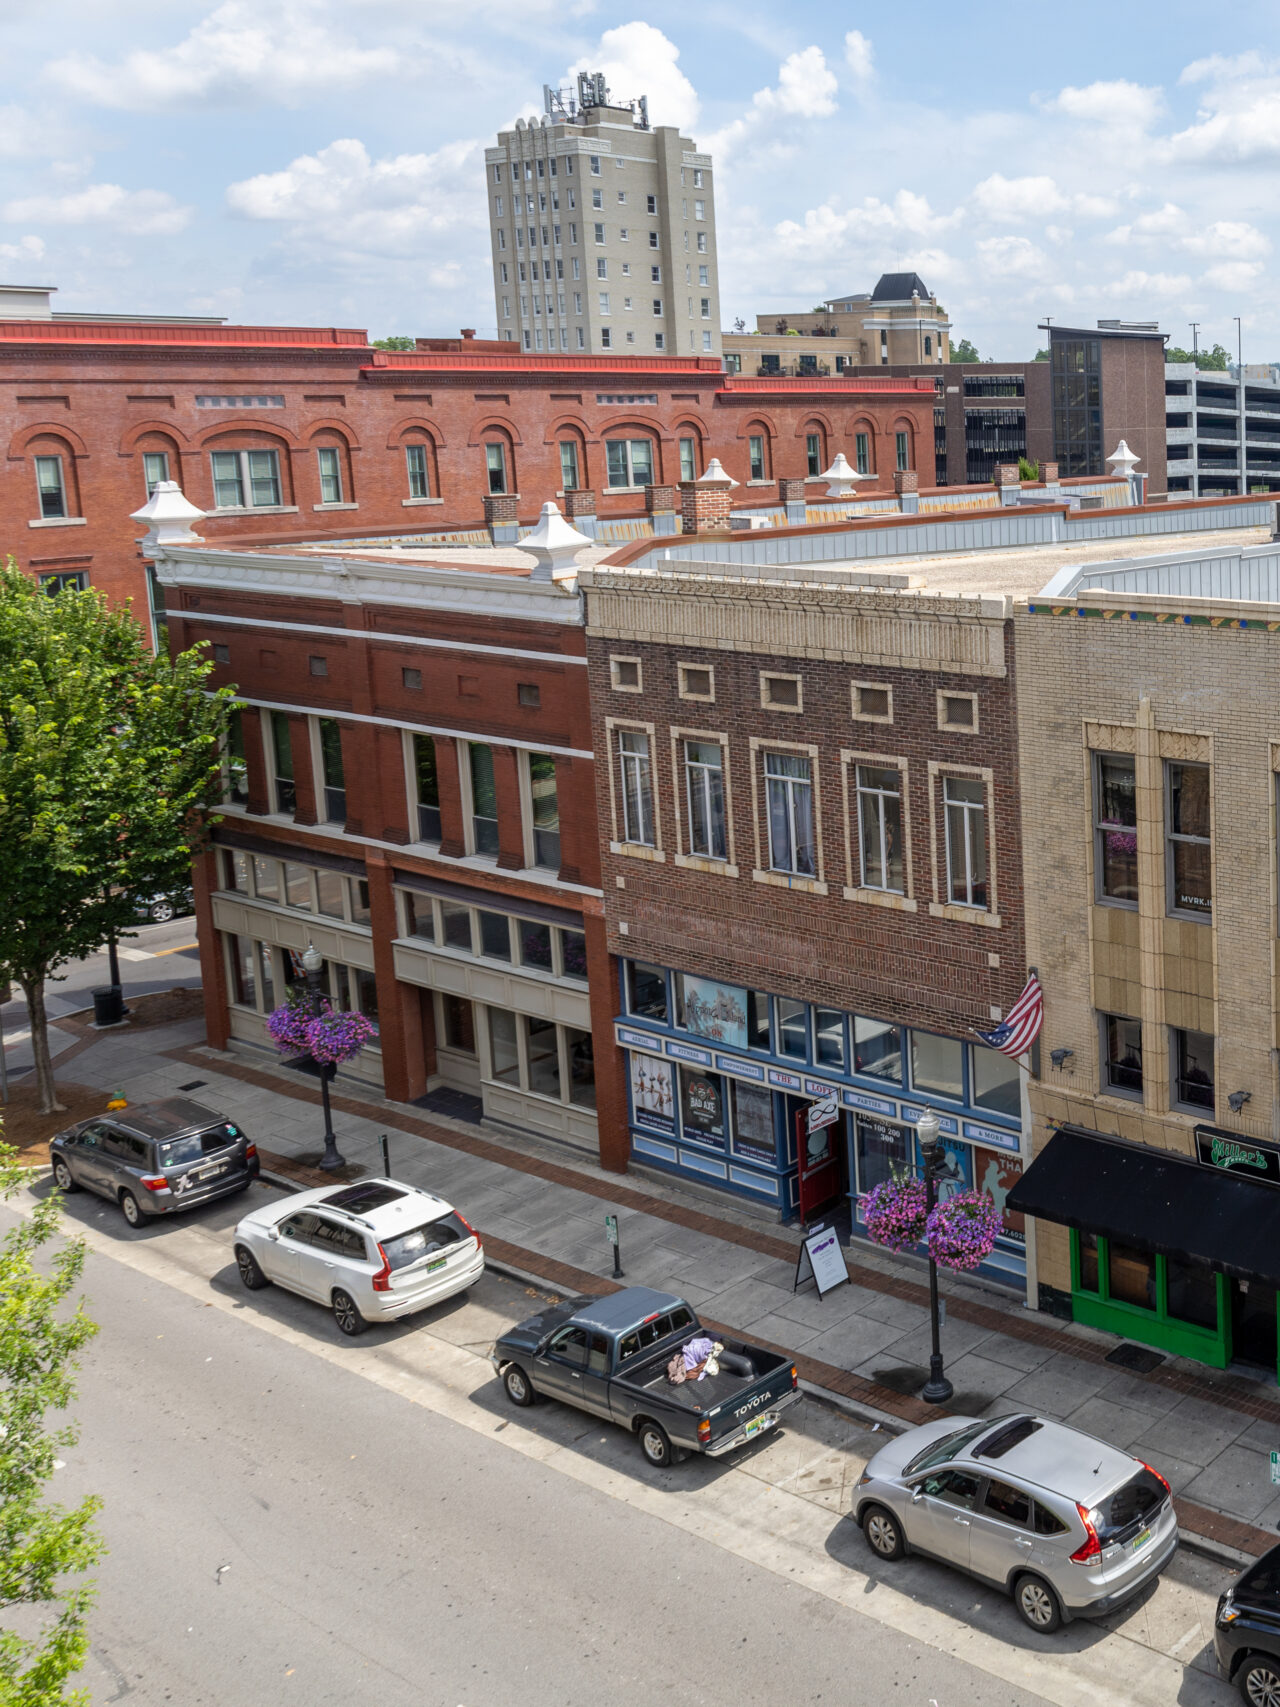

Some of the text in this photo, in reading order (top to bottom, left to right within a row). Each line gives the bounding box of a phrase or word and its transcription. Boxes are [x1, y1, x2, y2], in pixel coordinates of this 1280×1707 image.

[776, 1073, 832, 1096] THE LOFT
[690, 1097, 716, 1113] BAD AXE
[857, 1097, 881, 1109] PARTIES
[874, 1123, 886, 1133] 100
[887, 1127, 901, 1138] 200
[880, 1133, 894, 1143] 300
[984, 1132, 1004, 1142] MORE
[1211, 1138, 1267, 1168] Miller's
[999, 1159, 1022, 1173] THA
[733, 1391, 771, 1418] TOYOTA
